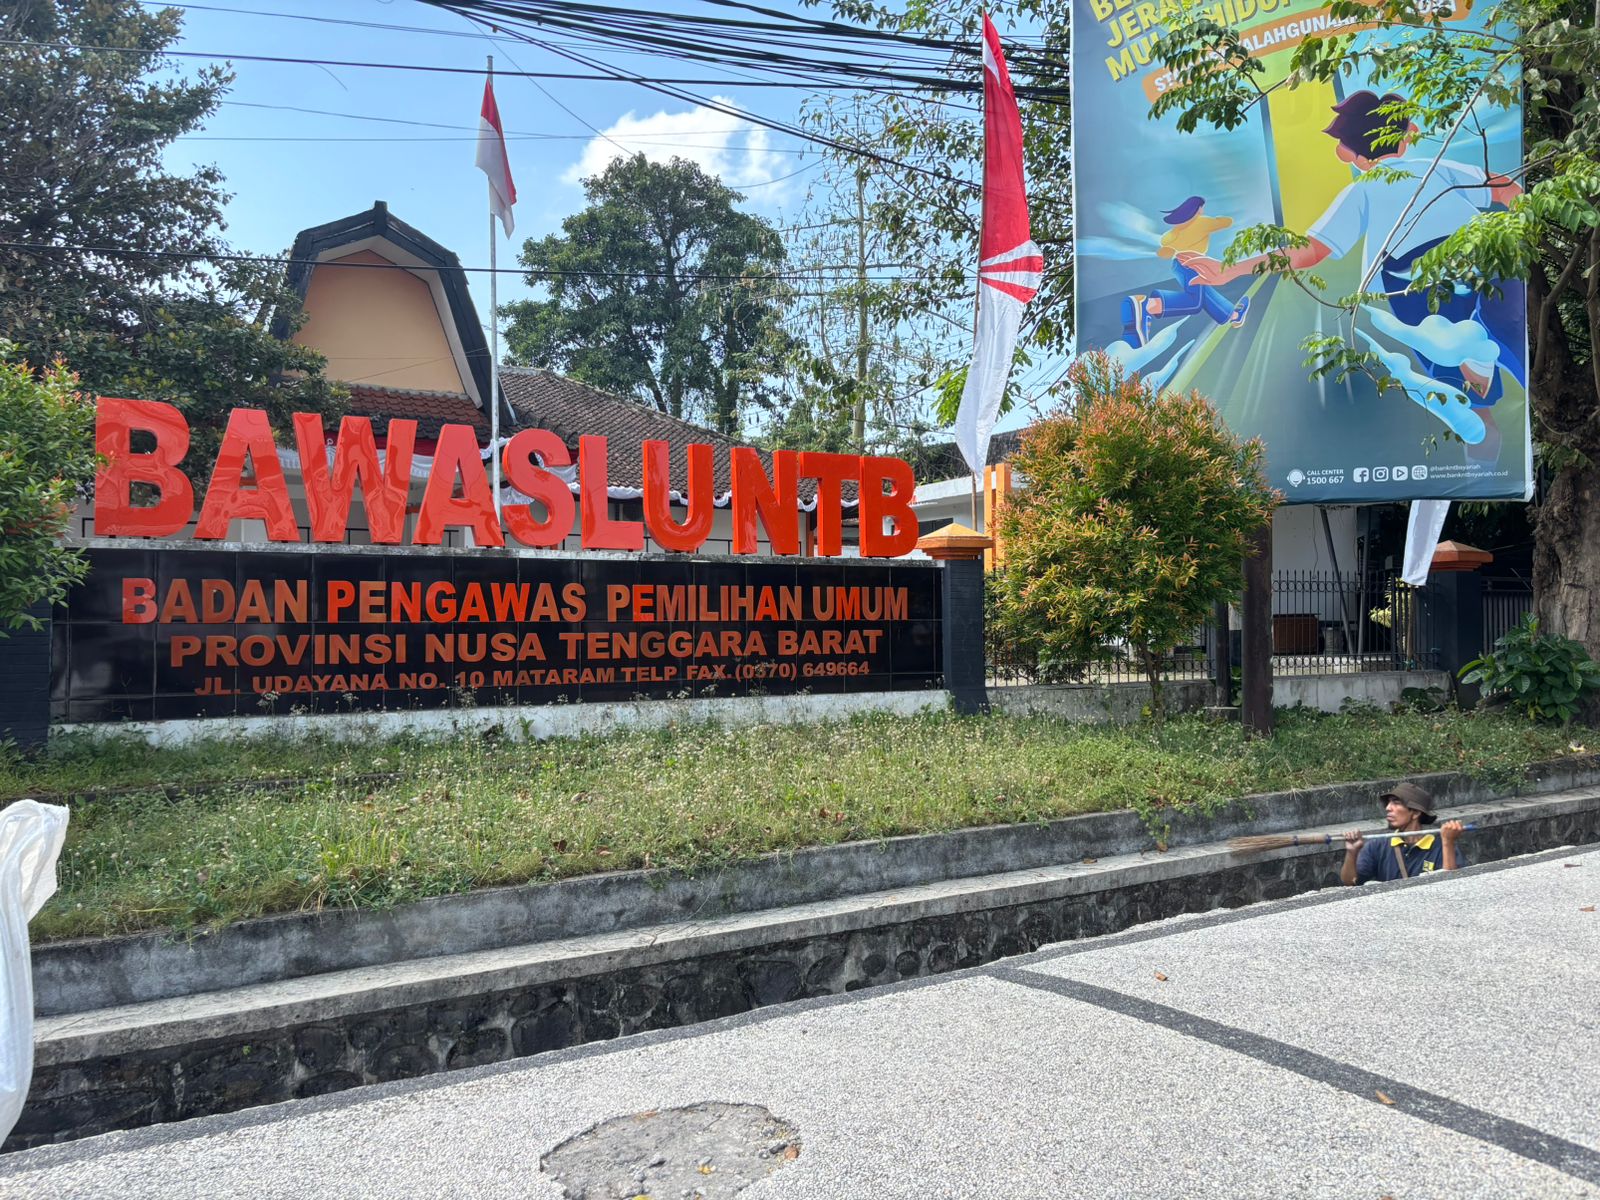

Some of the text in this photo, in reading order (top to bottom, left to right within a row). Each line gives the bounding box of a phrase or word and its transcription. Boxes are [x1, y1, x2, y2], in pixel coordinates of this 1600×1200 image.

[94, 396, 919, 558] BAWASLU NTB
[1306, 475, 1345, 485] 1500 667
[122, 577, 909, 624] BADAN PENGAWAS PEMILIHAN UMUM
[170, 629, 883, 668] PROVINSI NUSA TENGGARA BARAT
[195, 676, 241, 696] JL.
[252, 674, 389, 694] UDAYANA
[400, 672, 446, 690] NO.
[455, 671, 485, 688] 10
[493, 668, 615, 687] MATARAM
[621, 666, 677, 682] TELP
[686, 664, 732, 681] FAX.
[803, 661, 870, 677] 649664
